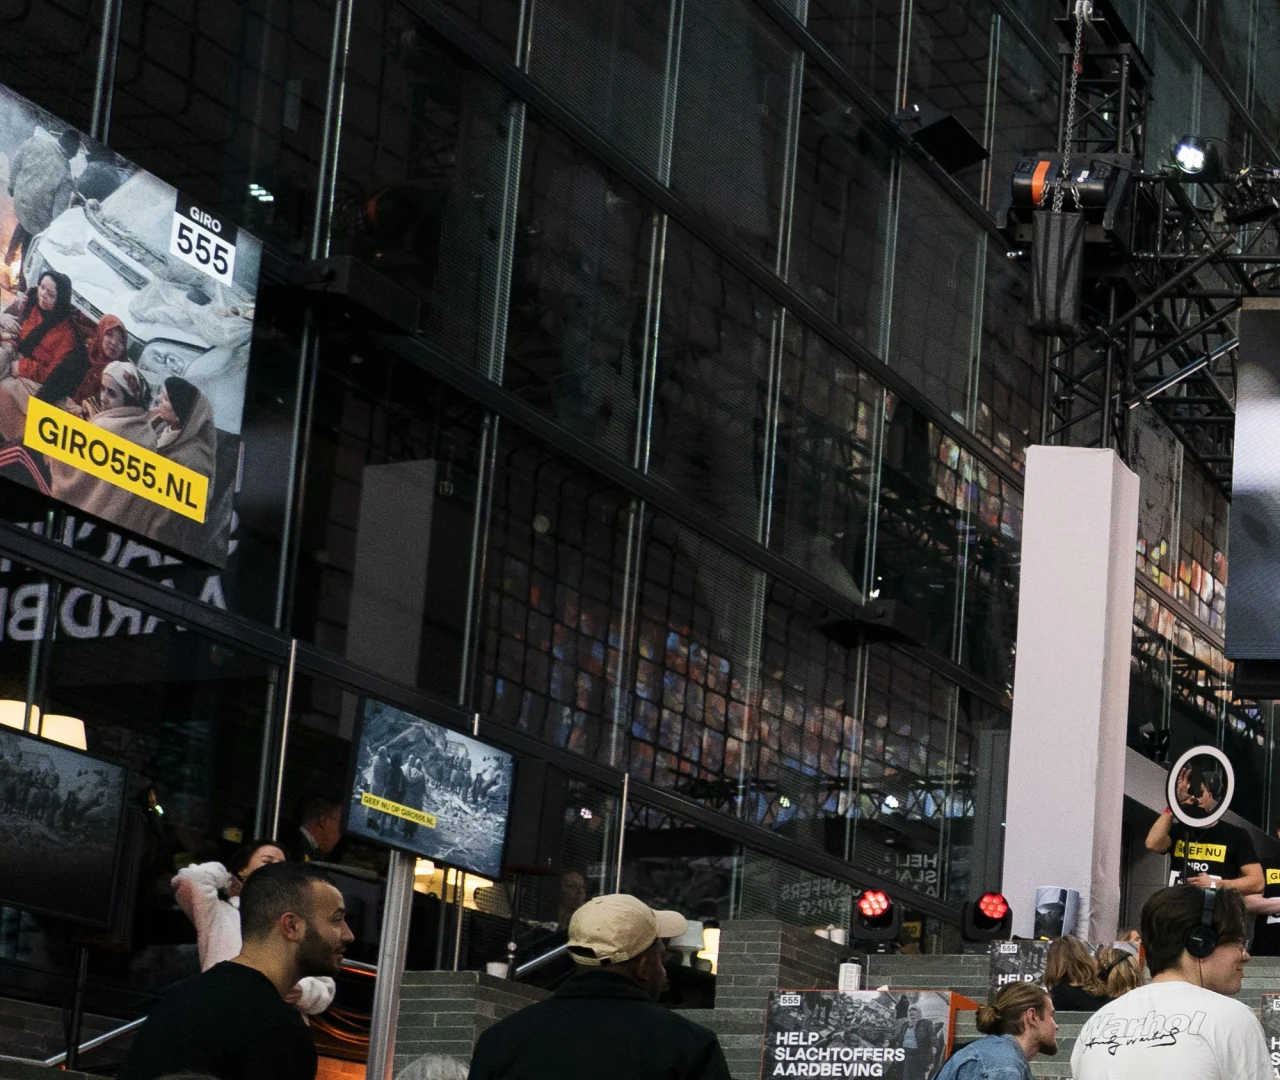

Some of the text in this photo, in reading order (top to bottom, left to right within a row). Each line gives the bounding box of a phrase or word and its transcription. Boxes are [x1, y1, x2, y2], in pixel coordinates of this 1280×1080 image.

[190, 205, 221, 233] GIRO
[176, 225, 229, 276] 555
[37, 415, 198, 511] GIRO555.NL
[1206, 846, 1221, 857] NU
[782, 996, 799, 1005] 555
[776, 1032, 820, 1046] HELP
[774, 1047, 906, 1062] SLACHTOFFERS
[773, 1062, 883, 1077] AARDBEVING
